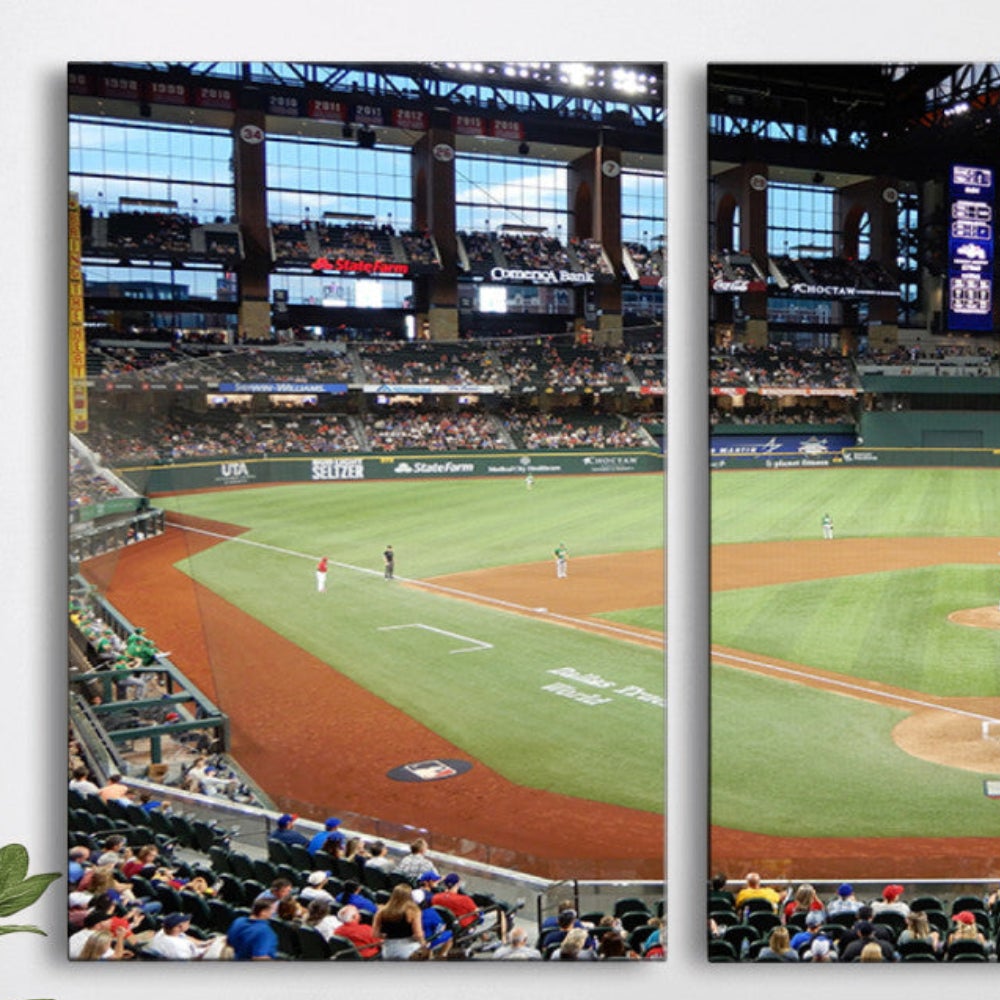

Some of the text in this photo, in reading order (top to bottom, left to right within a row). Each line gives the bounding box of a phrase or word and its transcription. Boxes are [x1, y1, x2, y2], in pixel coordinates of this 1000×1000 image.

[243, 128, 261, 140] 34
[606, 162, 616, 173] 7
[559, 268, 595, 283] Bank
[221, 462, 248, 477] UTA
[311, 463, 364, 480] SELTZER
